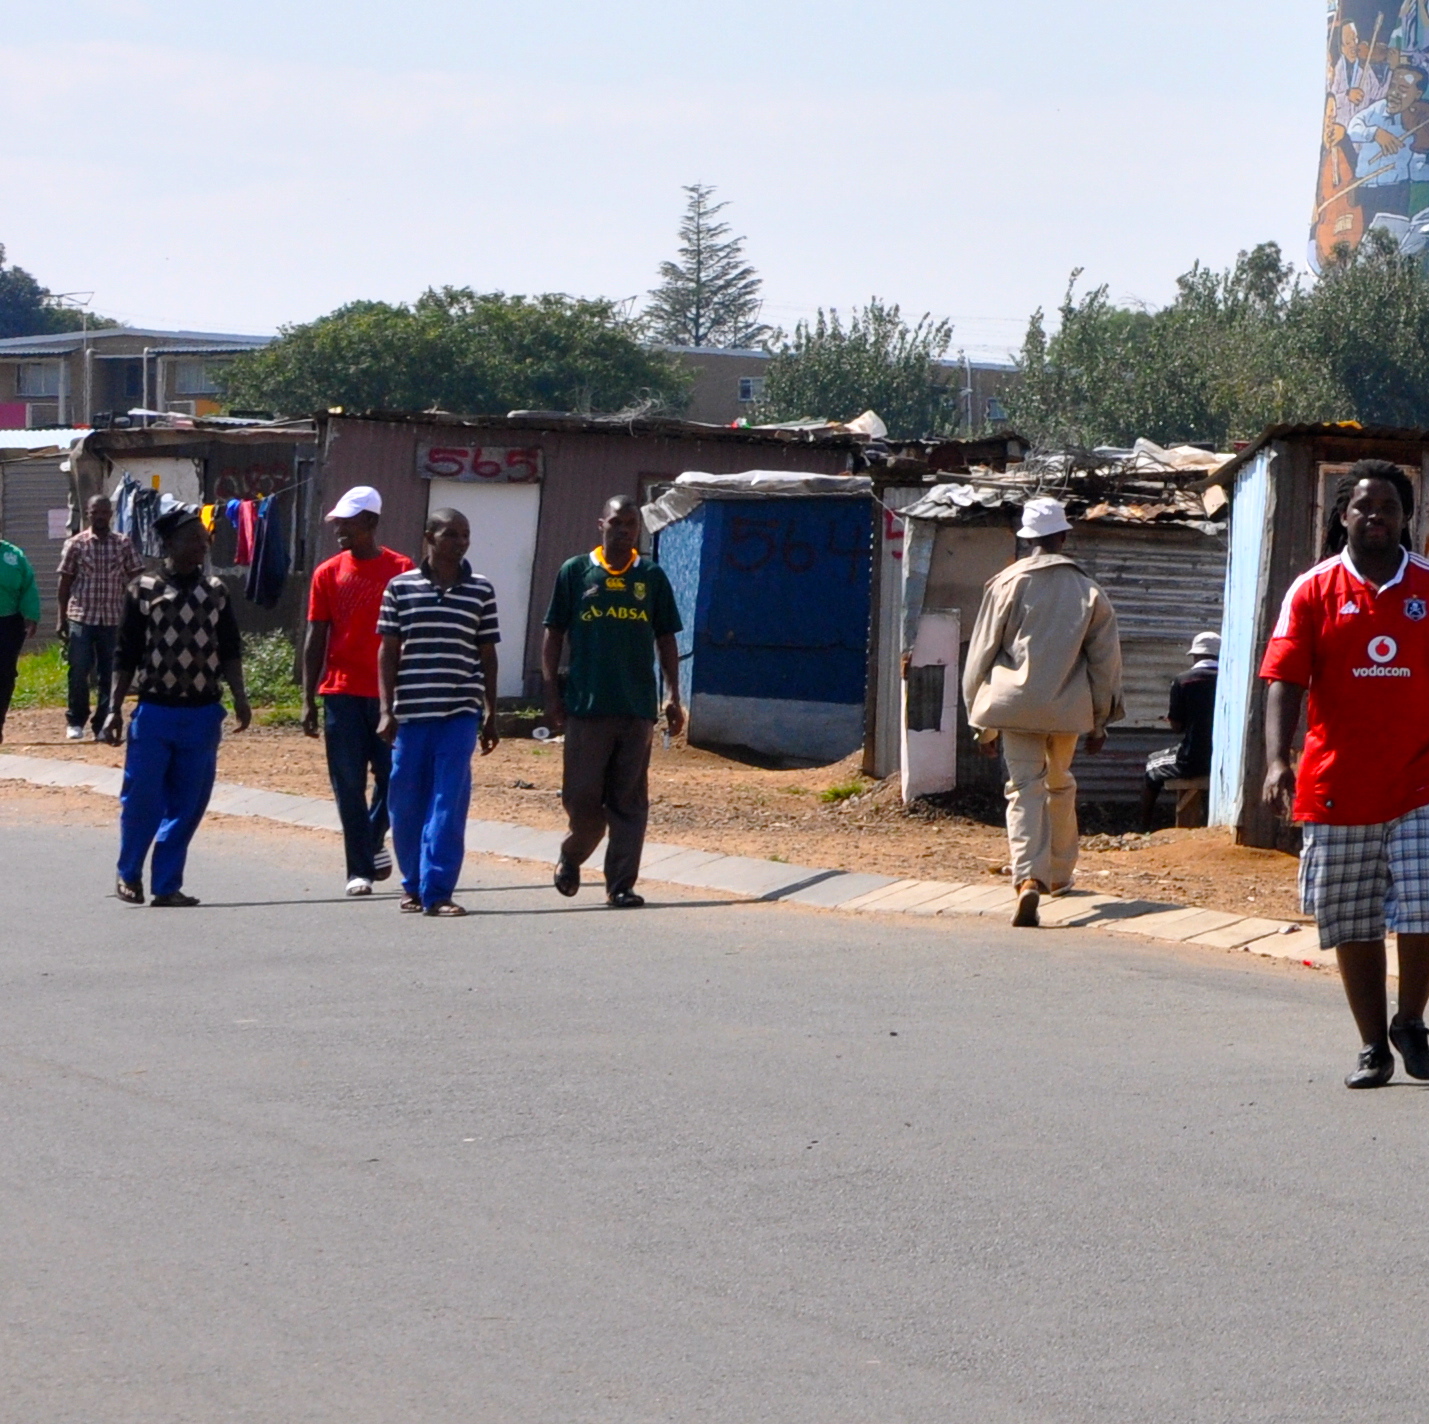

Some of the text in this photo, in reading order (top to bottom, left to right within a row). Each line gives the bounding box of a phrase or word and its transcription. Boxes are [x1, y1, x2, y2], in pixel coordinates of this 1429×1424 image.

[425, 447, 539, 482] 565
[725, 516, 872, 584] 564
[606, 606, 648, 622] ABSA
[1352, 664, 1411, 678] vodacom
